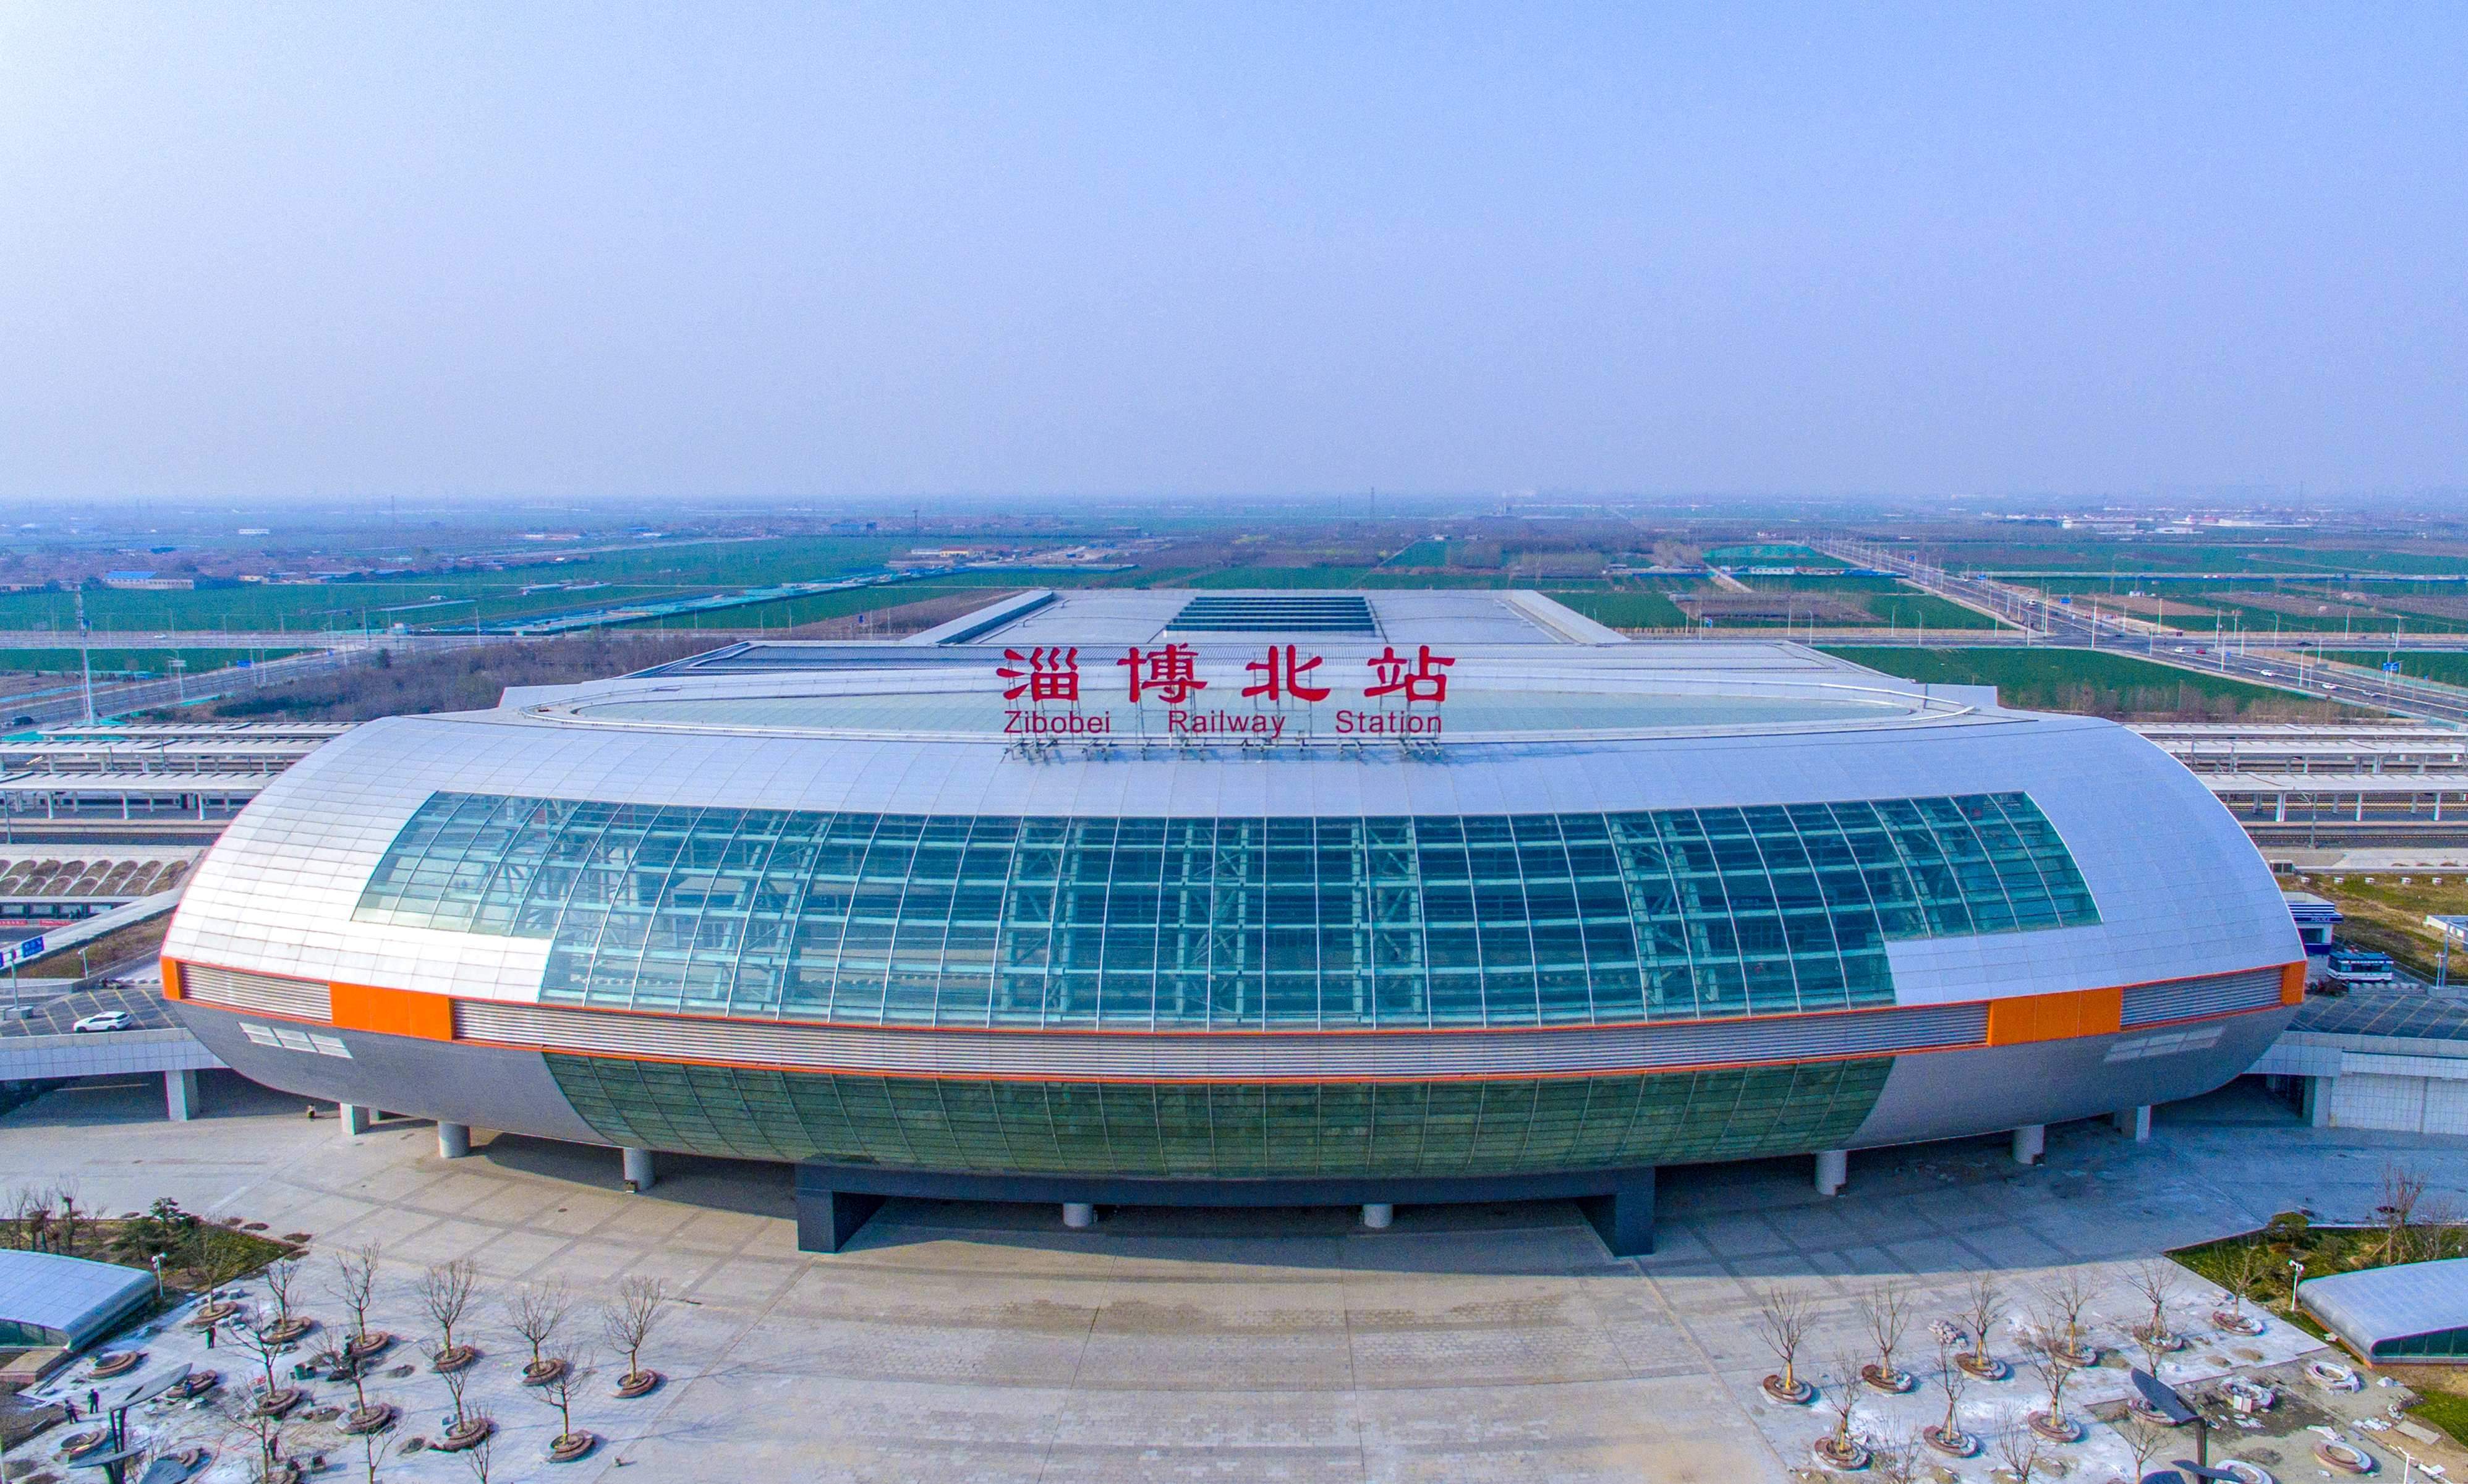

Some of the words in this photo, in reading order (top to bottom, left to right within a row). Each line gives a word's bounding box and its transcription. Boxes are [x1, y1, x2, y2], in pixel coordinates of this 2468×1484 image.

[996, 643, 1456, 705] 淄博北站
[1004, 710, 1110, 734] Zibobei
[1168, 710, 1285, 740] Railway
[1336, 710, 1442, 734] Station
